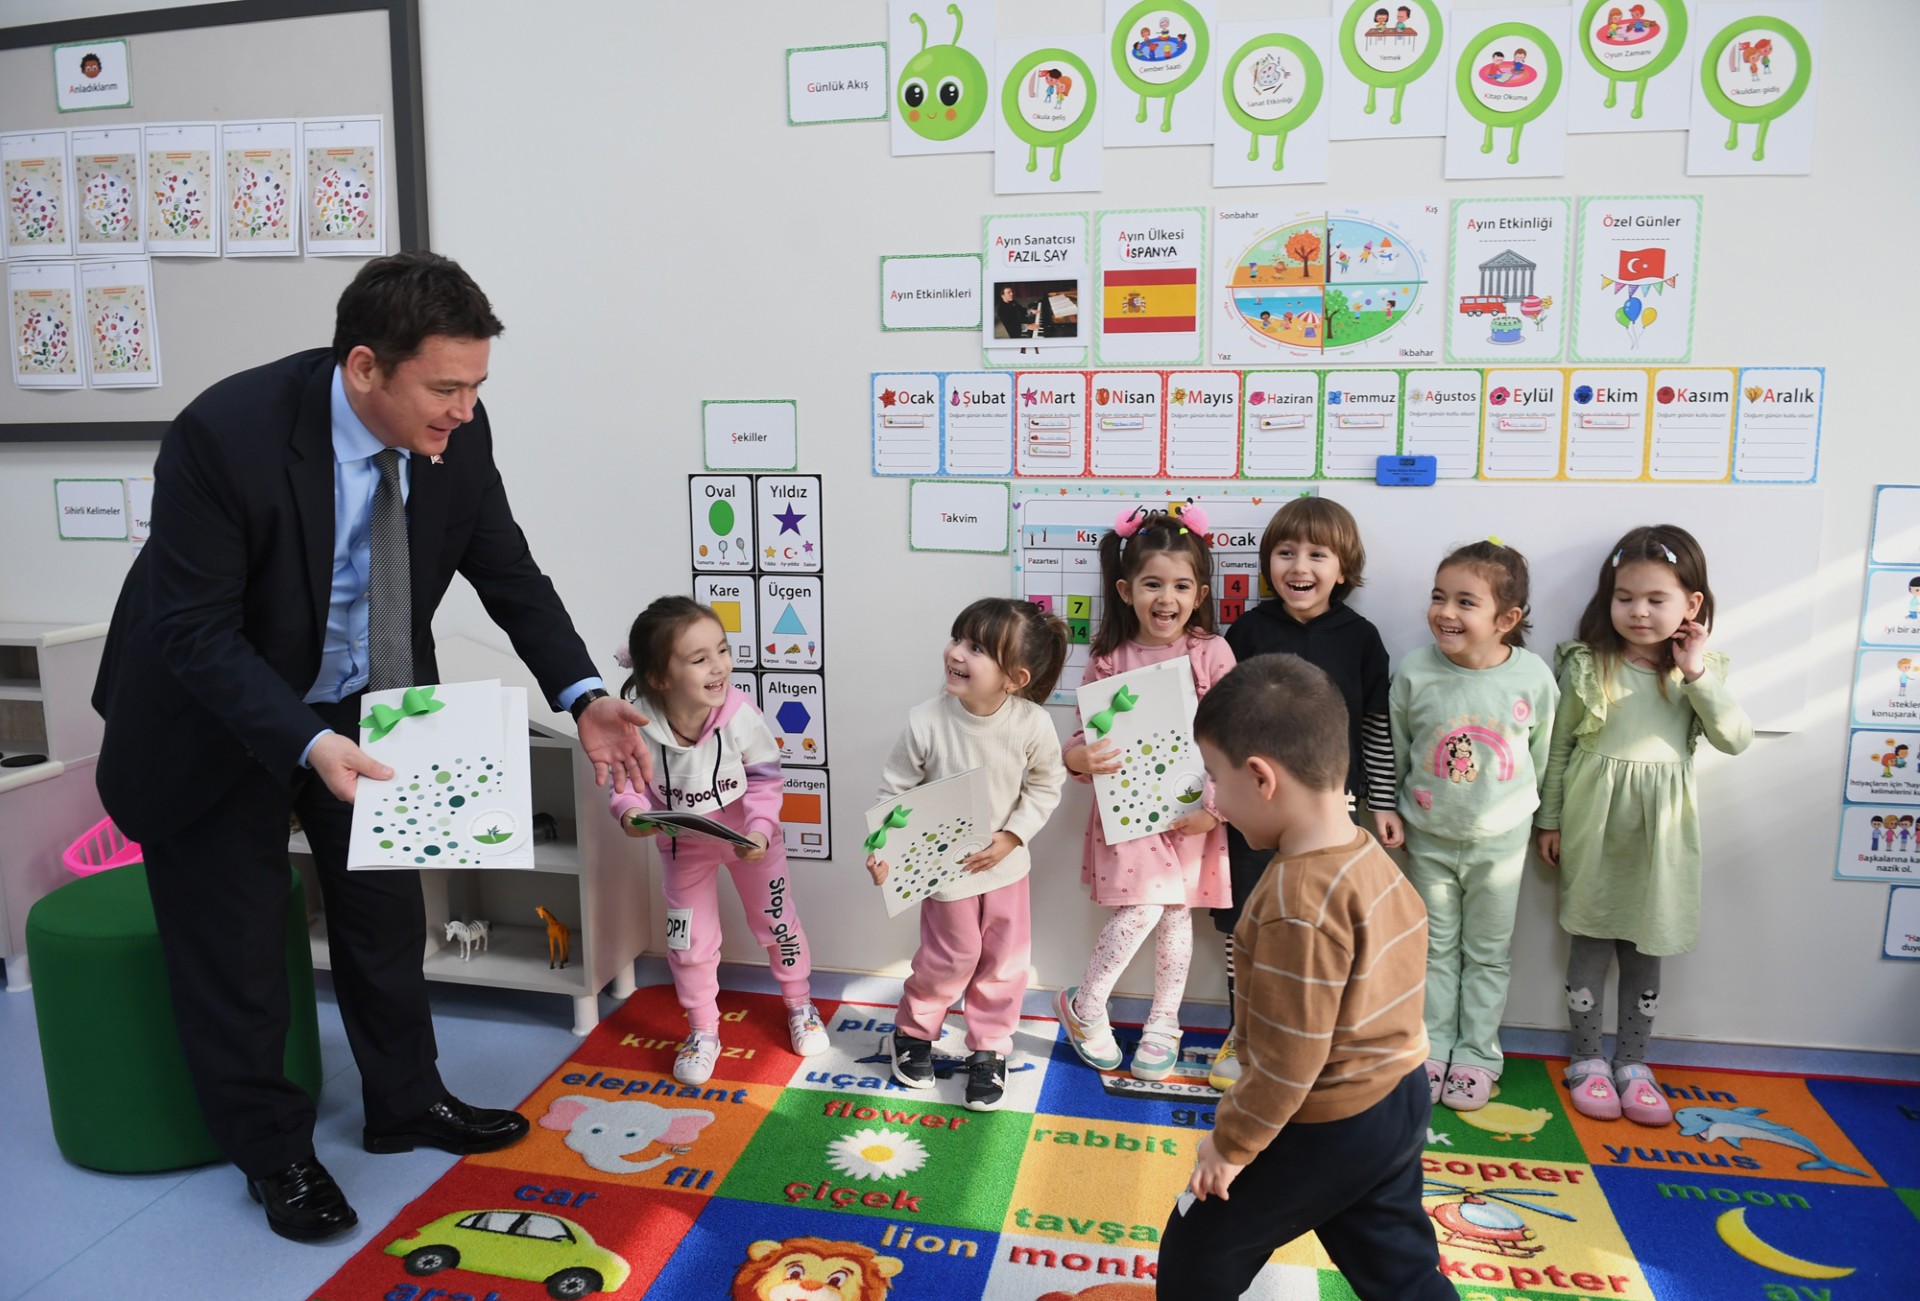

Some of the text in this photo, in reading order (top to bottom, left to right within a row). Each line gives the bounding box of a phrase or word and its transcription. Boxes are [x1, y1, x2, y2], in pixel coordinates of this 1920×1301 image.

[1380, 54, 1401, 62] Yemek
[1604, 48, 1652, 60] Oyun Zamanı
[68, 82, 118, 95] Anladıklarım
[807, 78, 869, 94] Günlük Akış
[1731, 86, 1762, 96] Okuldan
[1247, 100, 1264, 108] Sanat
[1484, 93, 1528, 103] Kitap Okuma
[1032, 113, 1049, 121] Okula
[1220, 210, 1259, 220] Sonbahar
[1425, 205, 1438, 214] Kış
[1467, 217, 1553, 232] Ayın Etkinliği
[1602, 215, 1681, 228] Özel Günler
[996, 236, 1021, 248] Ayın
[1118, 228, 1184, 242] Ayın Ülkesi
[1008, 249, 1068, 263] FAZIL SAY
[891, 288, 972, 302] Ayın Etkinlikleri
[1218, 352, 1232, 361] Yaz
[898, 390, 935, 404] Ocak
[963, 390, 1006, 408] Şubat
[1040, 390, 1076, 404] Mart
[1112, 390, 1155, 404] Nisan
[1188, 390, 1234, 408] Mayıs
[1268, 393, 1313, 404] Haziran
[1343, 392, 1396, 404] Temmuz
[1425, 390, 1476, 404] Ağustos
[1514, 388, 1554, 406] Eylül
[1596, 388, 1638, 403] Ekim
[1677, 388, 1730, 403] Kasım
[1762, 388, 1814, 404] Aralık
[732, 432, 767, 444] Şekiller
[704, 484, 736, 498] Oval
[770, 484, 808, 498] Yıldız
[64, 506, 120, 515] Sihirli Kelimeler
[941, 512, 978, 524] Takvim
[1077, 530, 1098, 546] Kış
[1217, 532, 1256, 547] Ocak
[1028, 558, 1059, 566] Pazartesi
[710, 584, 740, 597] Kare
[768, 582, 812, 600] Üçgen
[1231, 580, 1241, 592] 4
[1074, 602, 1083, 614] 7
[1224, 604, 1241, 618] 11
[1070, 626, 1087, 639] 14
[1898, 626, 1909, 634] bir
[768, 682, 817, 697] Altıgen
[1872, 710, 1917, 719] konuşarak
[718, 779, 738, 793] life
[784, 778, 826, 791] dörtgen
[1858, 854, 1908, 863] Başkalarına
[1876, 864, 1900, 872] nazik
[764, 876, 785, 919] Stop
[667, 919, 686, 938] OP!
[619, 1033, 756, 1060] kırzı
[562, 1070, 749, 1104] elephant
[824, 1100, 969, 1131] flower
[1033, 1126, 1178, 1156] rabbit
[1602, 1144, 1762, 1170] yunus
[1421, 1157, 1584, 1184] copter
[664, 1166, 715, 1190] fil
[515, 1183, 598, 1209] car
[784, 1180, 923, 1214] çiçek
[1656, 1182, 1812, 1210] moon
[1014, 1208, 1160, 1245] tavşa
[880, 1224, 979, 1259] lion
[1008, 1245, 1158, 1280] monk
[1436, 1254, 1630, 1293] kopter
